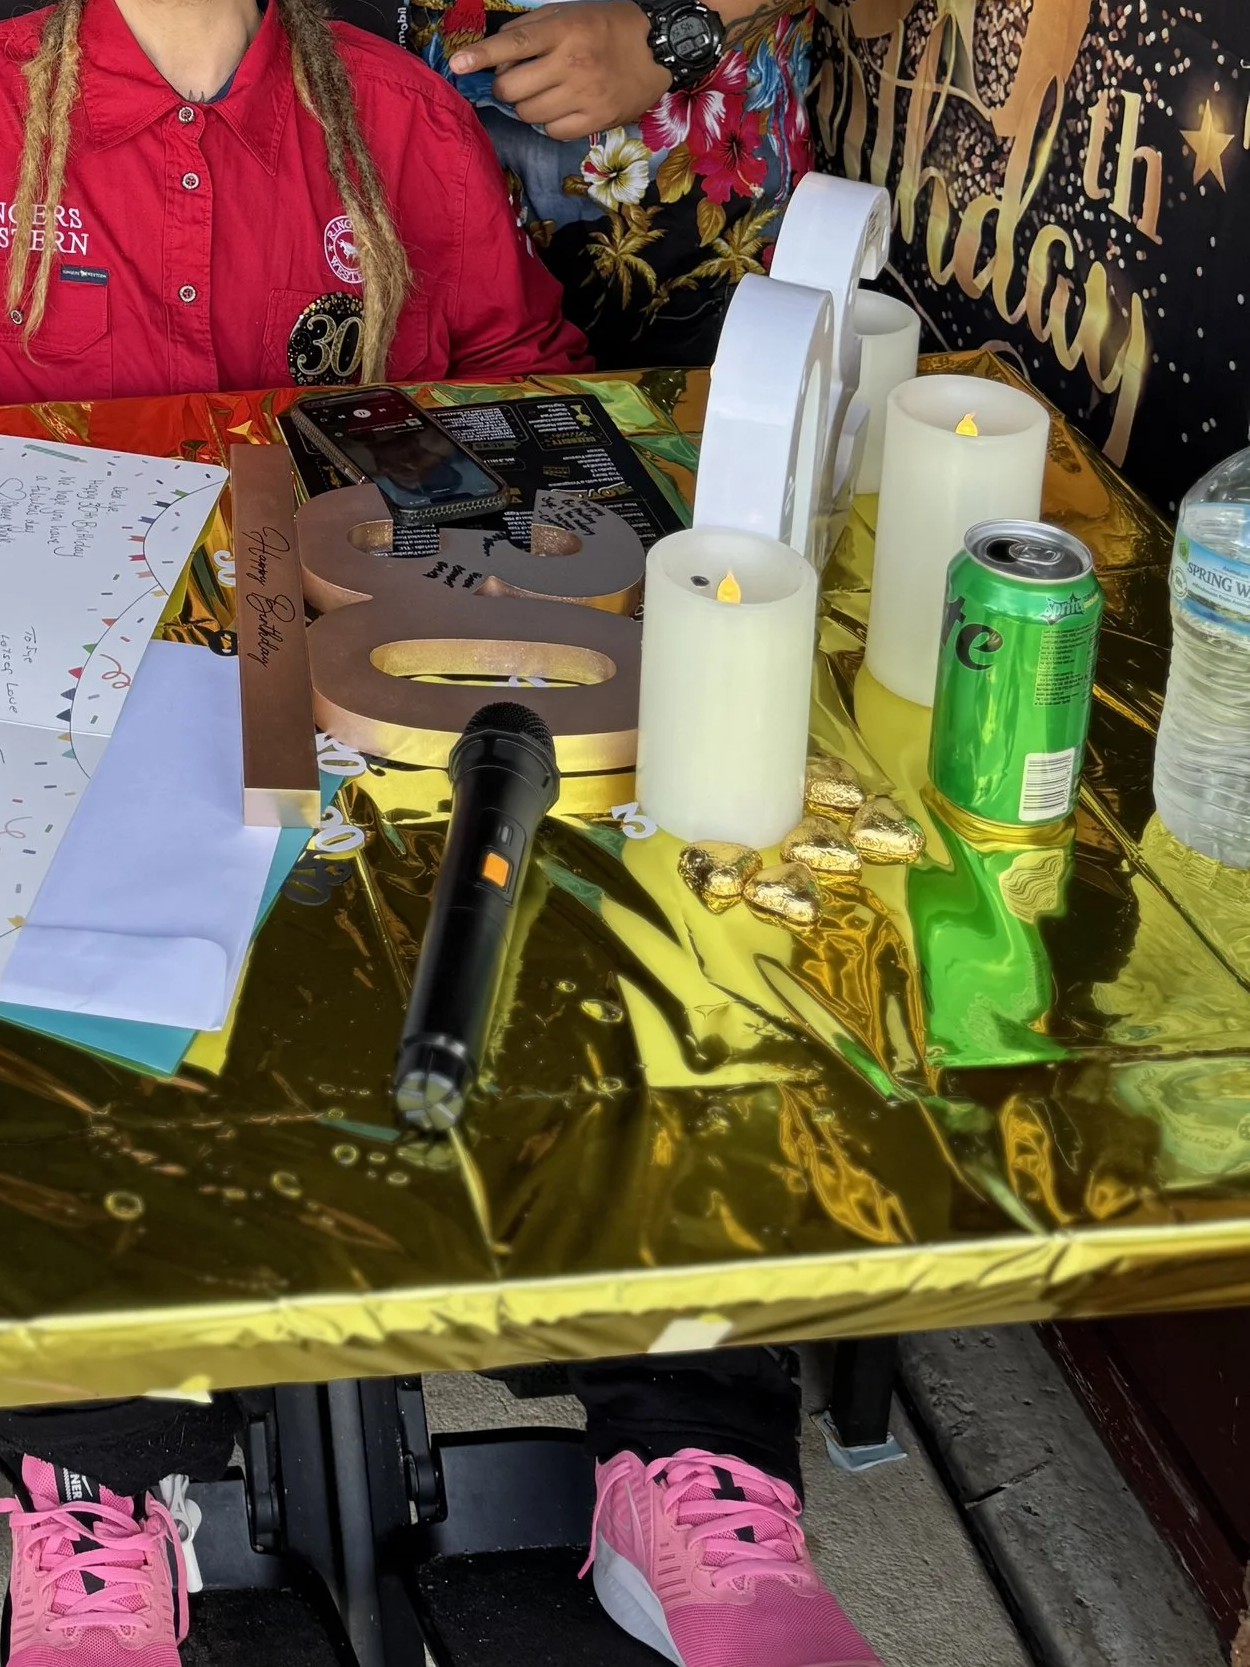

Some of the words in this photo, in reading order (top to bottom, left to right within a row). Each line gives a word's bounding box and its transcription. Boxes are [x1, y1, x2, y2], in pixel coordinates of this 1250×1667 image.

[326, 219, 353, 248] RING
[297, 313, 364, 378] 30
[49, 490, 73, 506] hope
[77, 479, 104, 500] Happy
[111, 486, 128, 499] Dear
[39, 510, 64, 522] you
[47, 526, 67, 545] have
[54, 520, 97, 558] Birthday
[242, 526, 291, 586] Happy
[1187, 562, 1233, 593] SPRING
[24, 626, 36, 644] To
[246, 592, 296, 670] Birthday
[69, 1473, 83, 1499] NER
